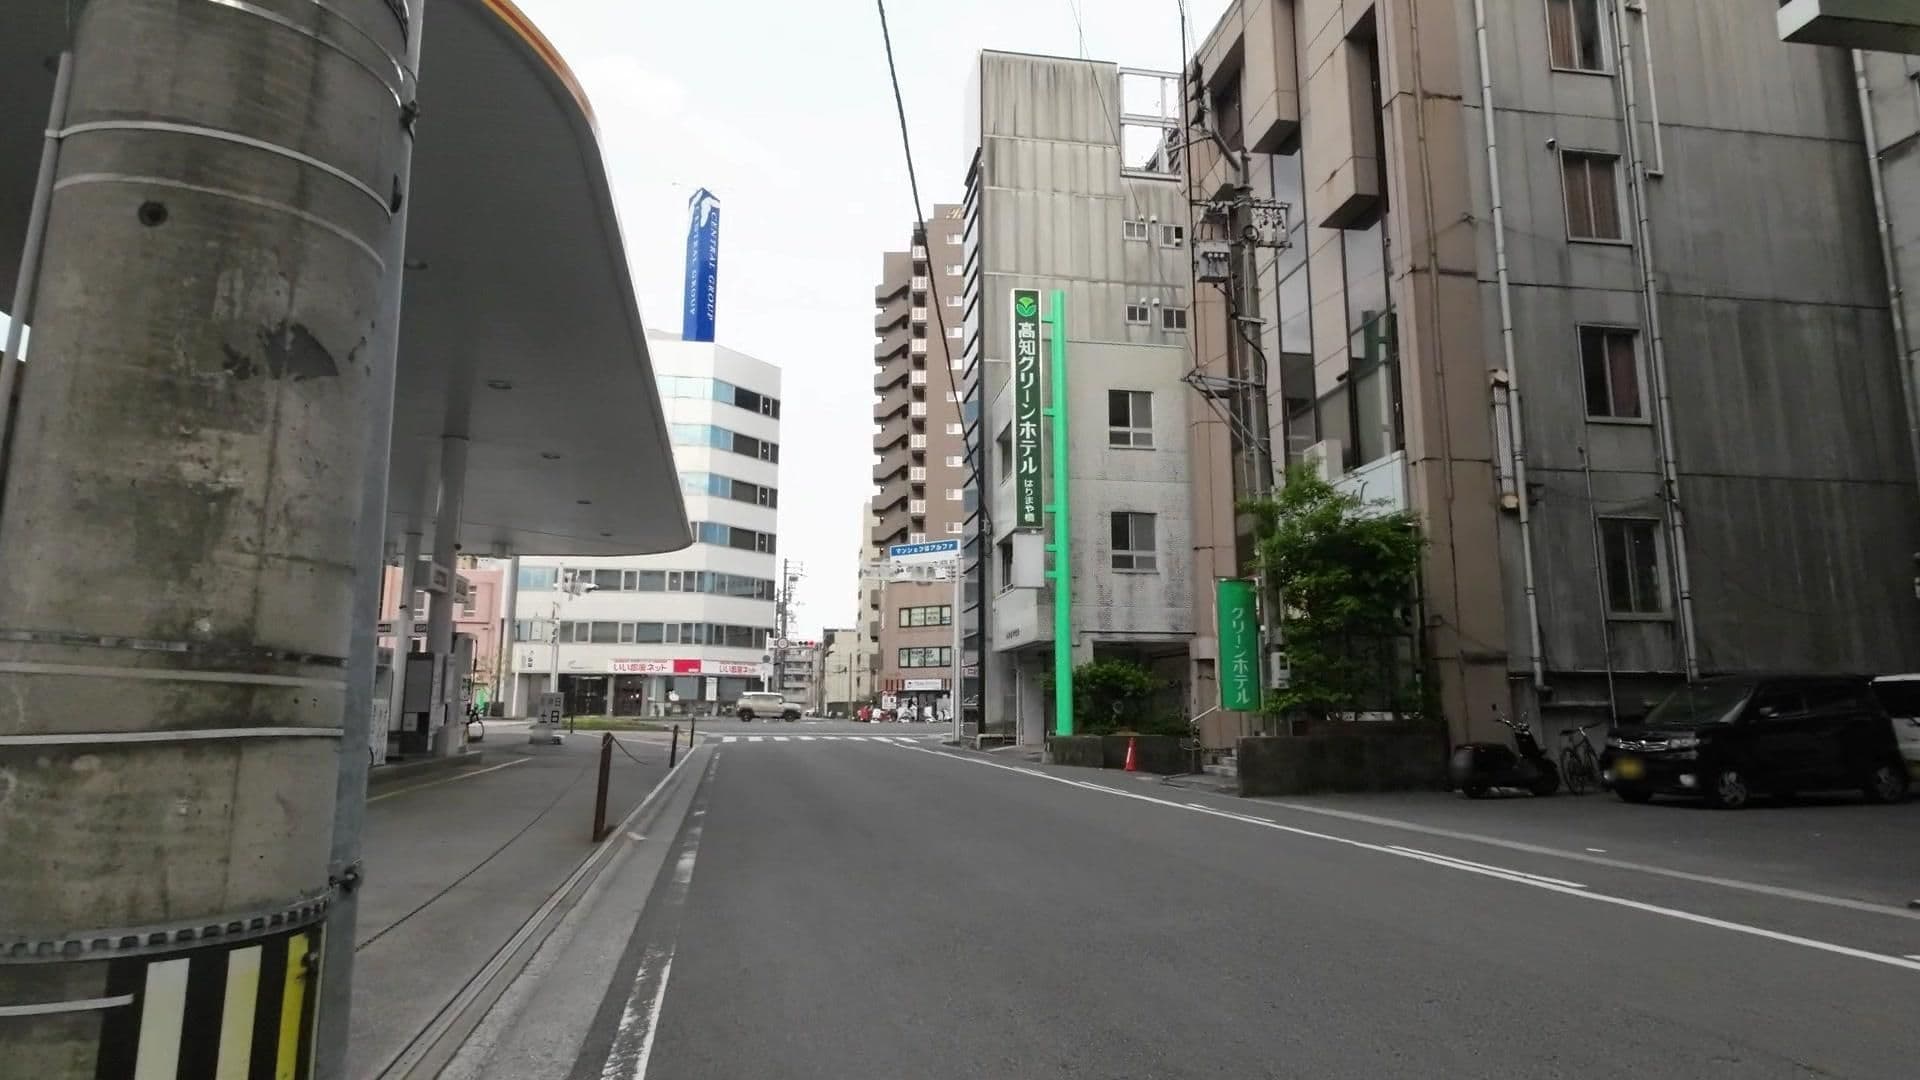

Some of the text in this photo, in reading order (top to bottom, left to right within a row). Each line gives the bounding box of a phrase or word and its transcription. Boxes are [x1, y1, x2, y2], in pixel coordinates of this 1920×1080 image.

[707, 212, 717, 321] CENTRAL GROUP
[1018, 322, 1038, 474] 高知クリーンホテル
[1231, 607, 1250, 705] クリーンホテル
